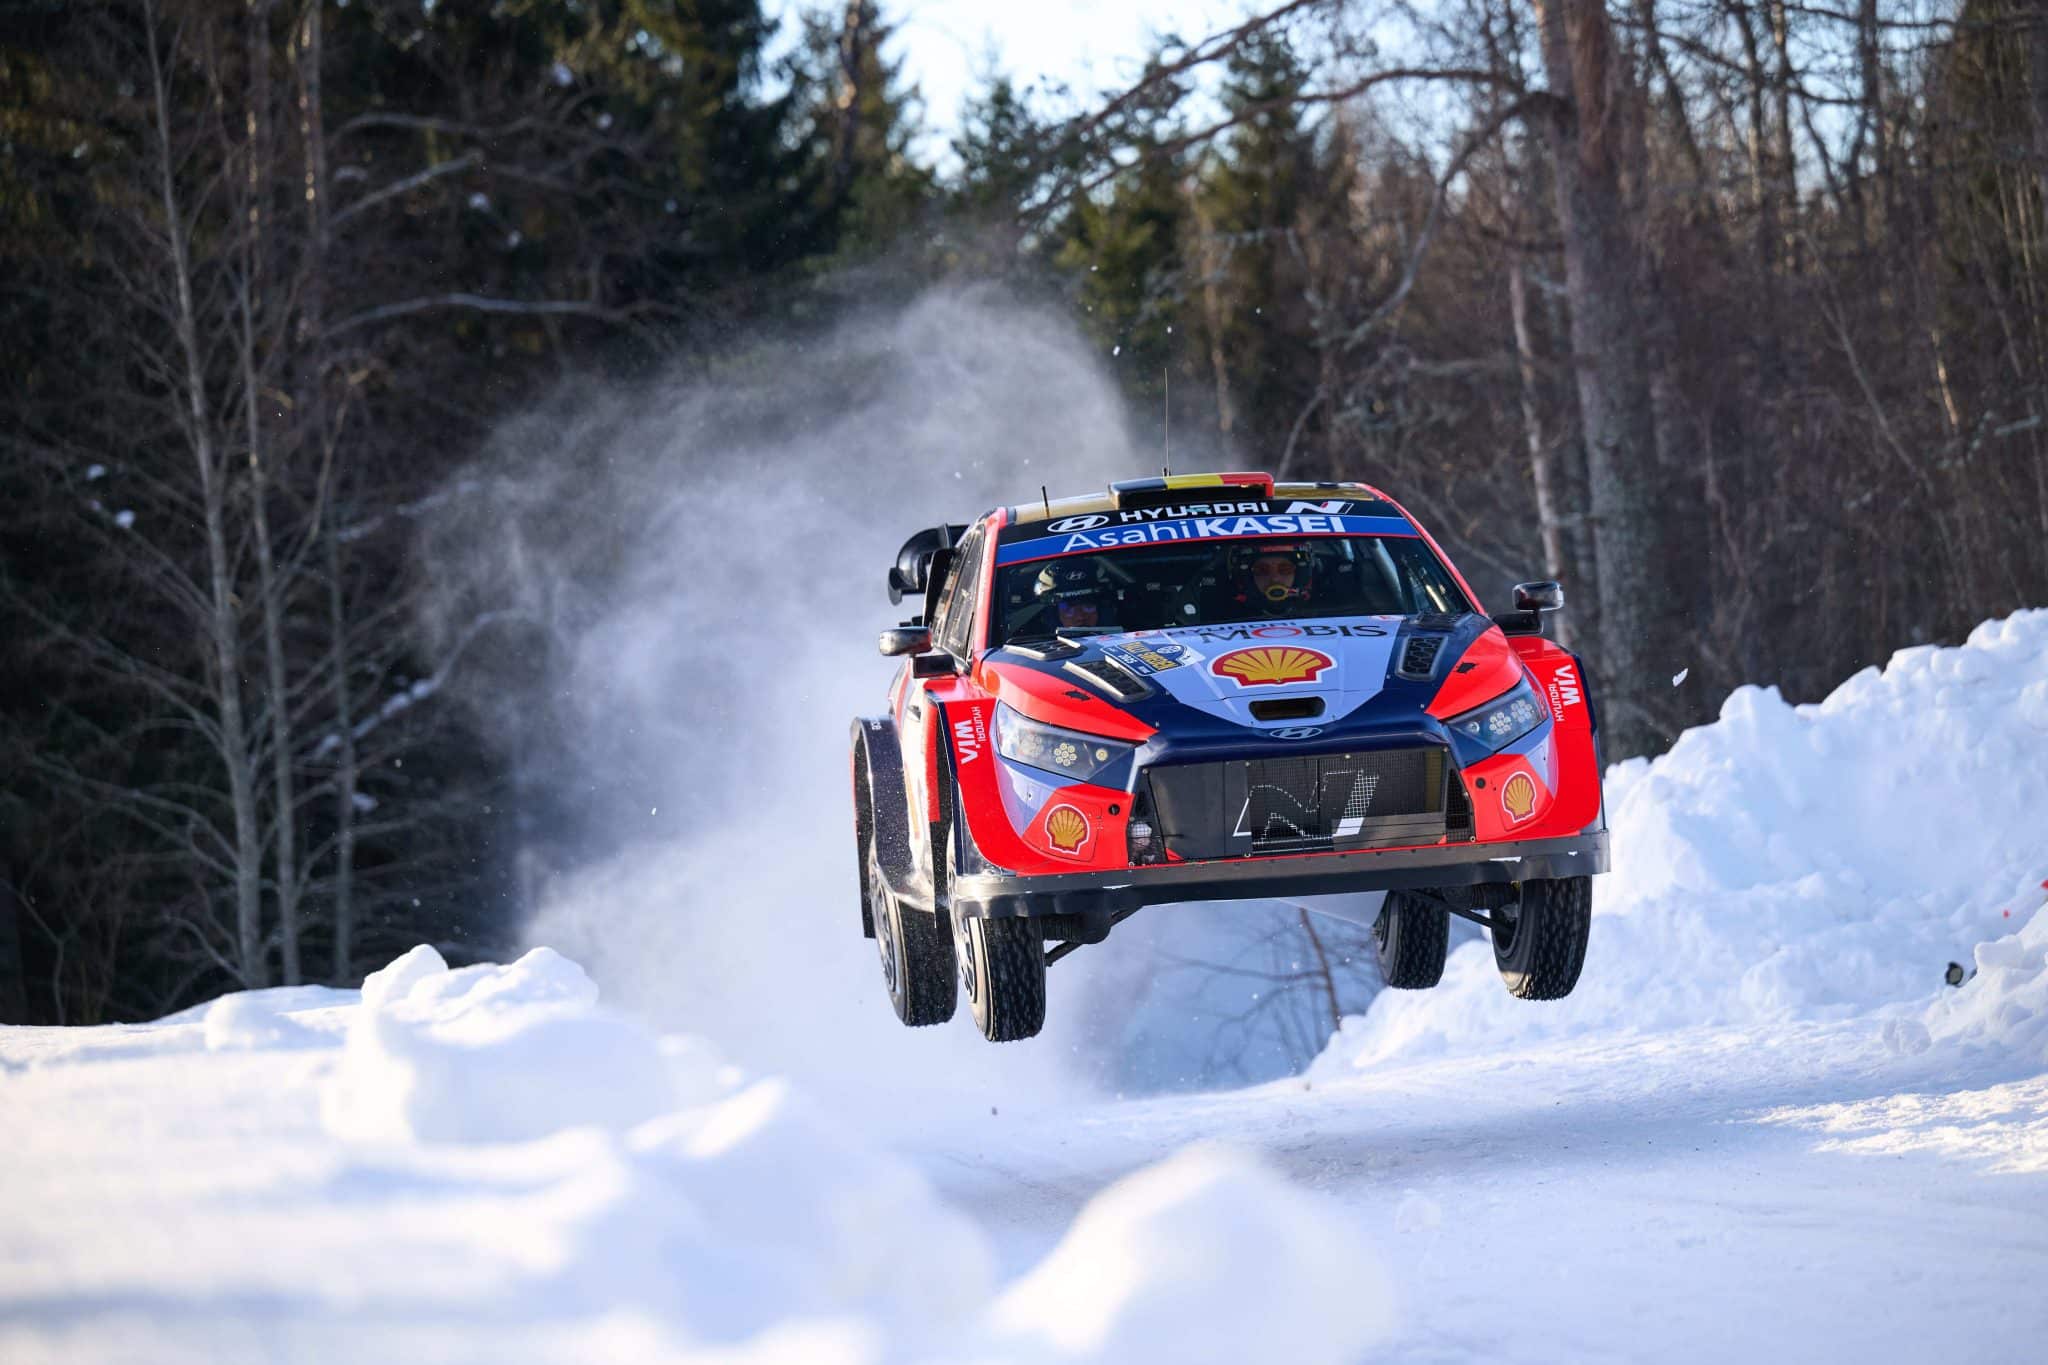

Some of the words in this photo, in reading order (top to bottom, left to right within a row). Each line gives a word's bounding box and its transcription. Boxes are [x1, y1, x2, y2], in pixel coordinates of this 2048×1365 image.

[1120, 503, 1270, 522] HYUNDAI
[1166, 621, 1297, 636] HYUNDAI
[1200, 624, 1388, 643] MOBIS
[1548, 683, 1565, 721] HYUNDAI
[971, 706, 986, 742] HYUNDAI
